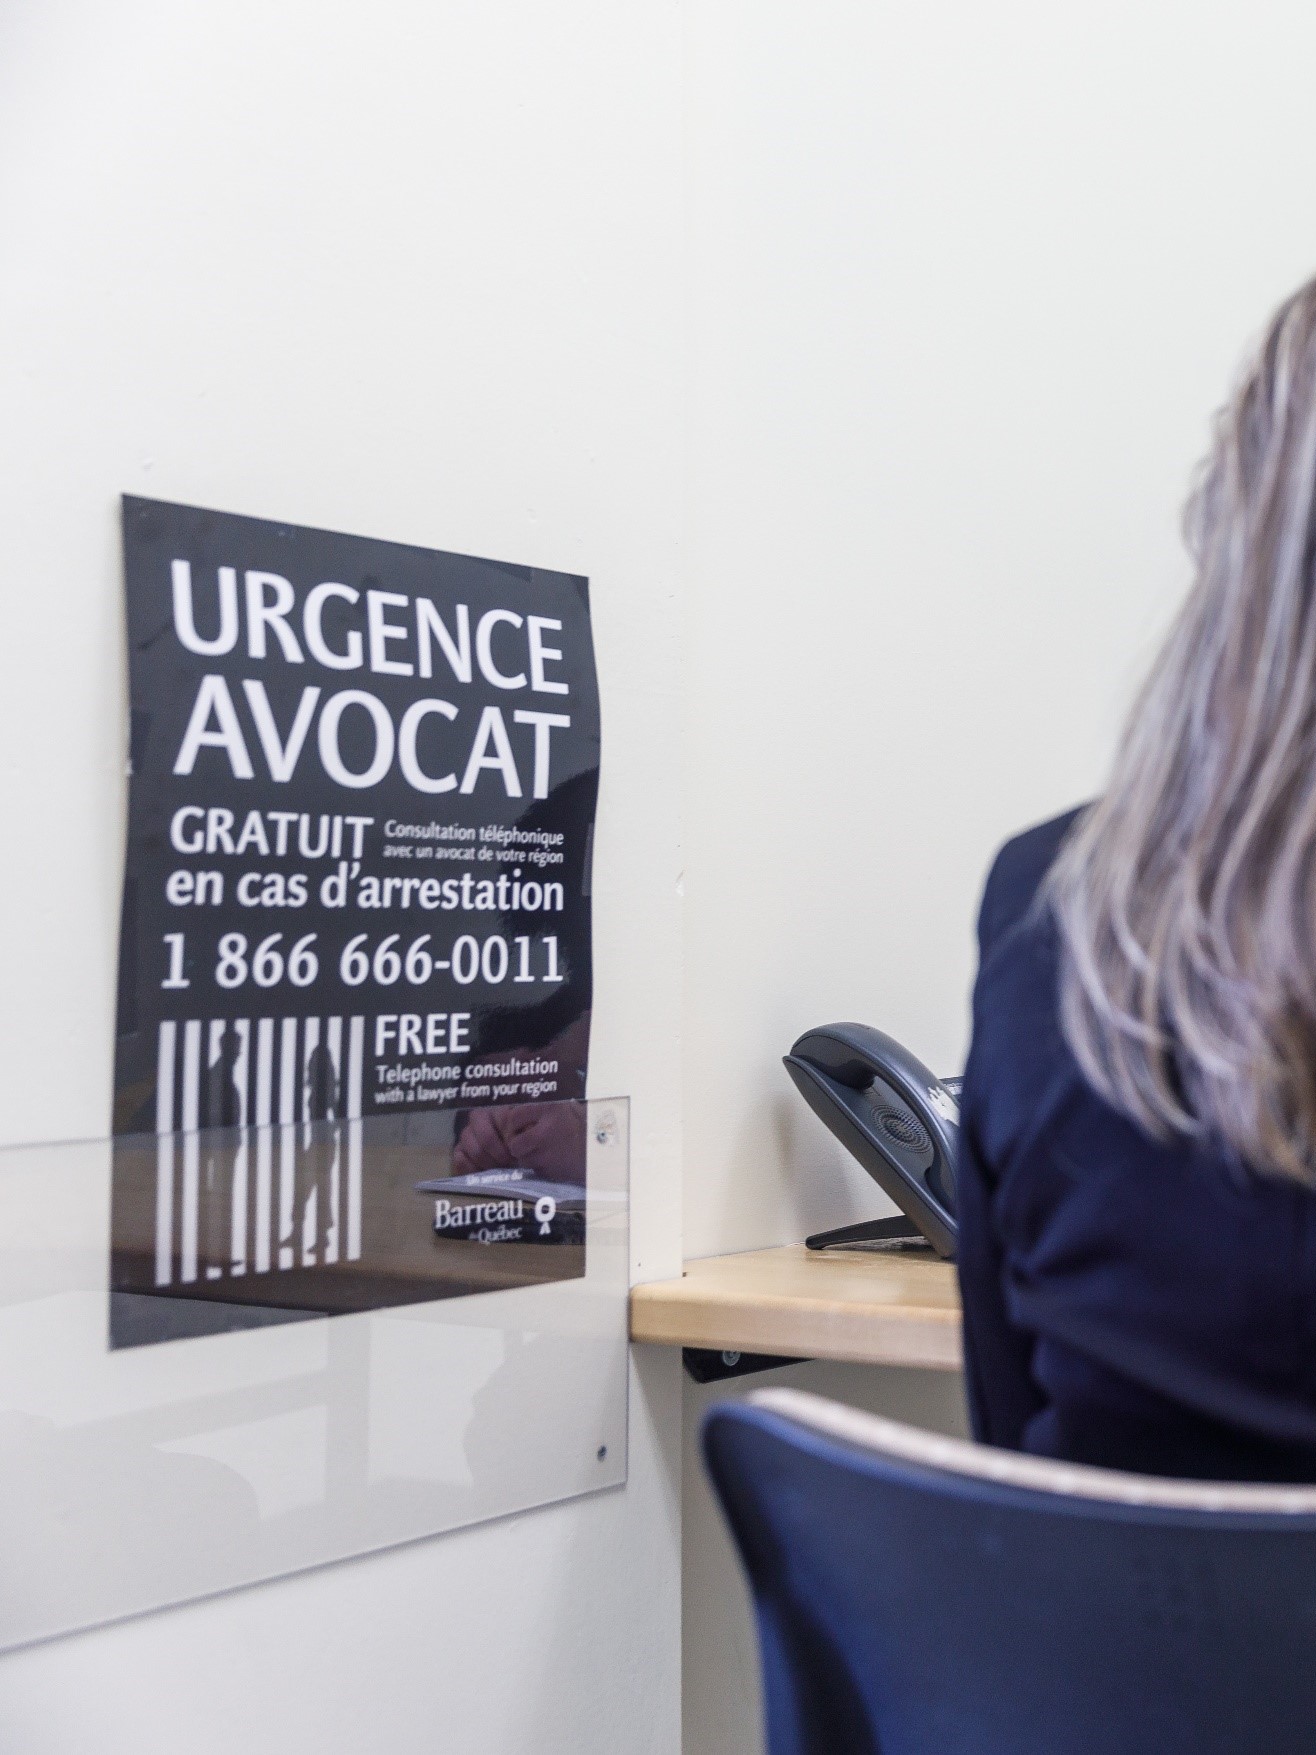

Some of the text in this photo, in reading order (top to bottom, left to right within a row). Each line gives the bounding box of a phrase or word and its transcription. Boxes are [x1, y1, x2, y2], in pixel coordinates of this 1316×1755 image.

[171, 558, 569, 696] URGENCE
[173, 673, 571, 800] AVOCAT
[170, 805, 375, 859] GRATUIT
[384, 819, 564, 848] Consultation téléphonique
[383, 845, 564, 868] avec un avocat de votre région
[166, 869, 224, 907] en
[236, 872, 309, 908] cas
[161, 932, 565, 989] 1 866 666-0011
[375, 1012, 471, 1057] FREE
[375, 1057, 559, 1087] Telephone consultation
[373, 1078, 558, 1105] with a lawyer from your region
[435, 1199, 524, 1229] Barreau
[478, 1224, 523, 1245] Québec
